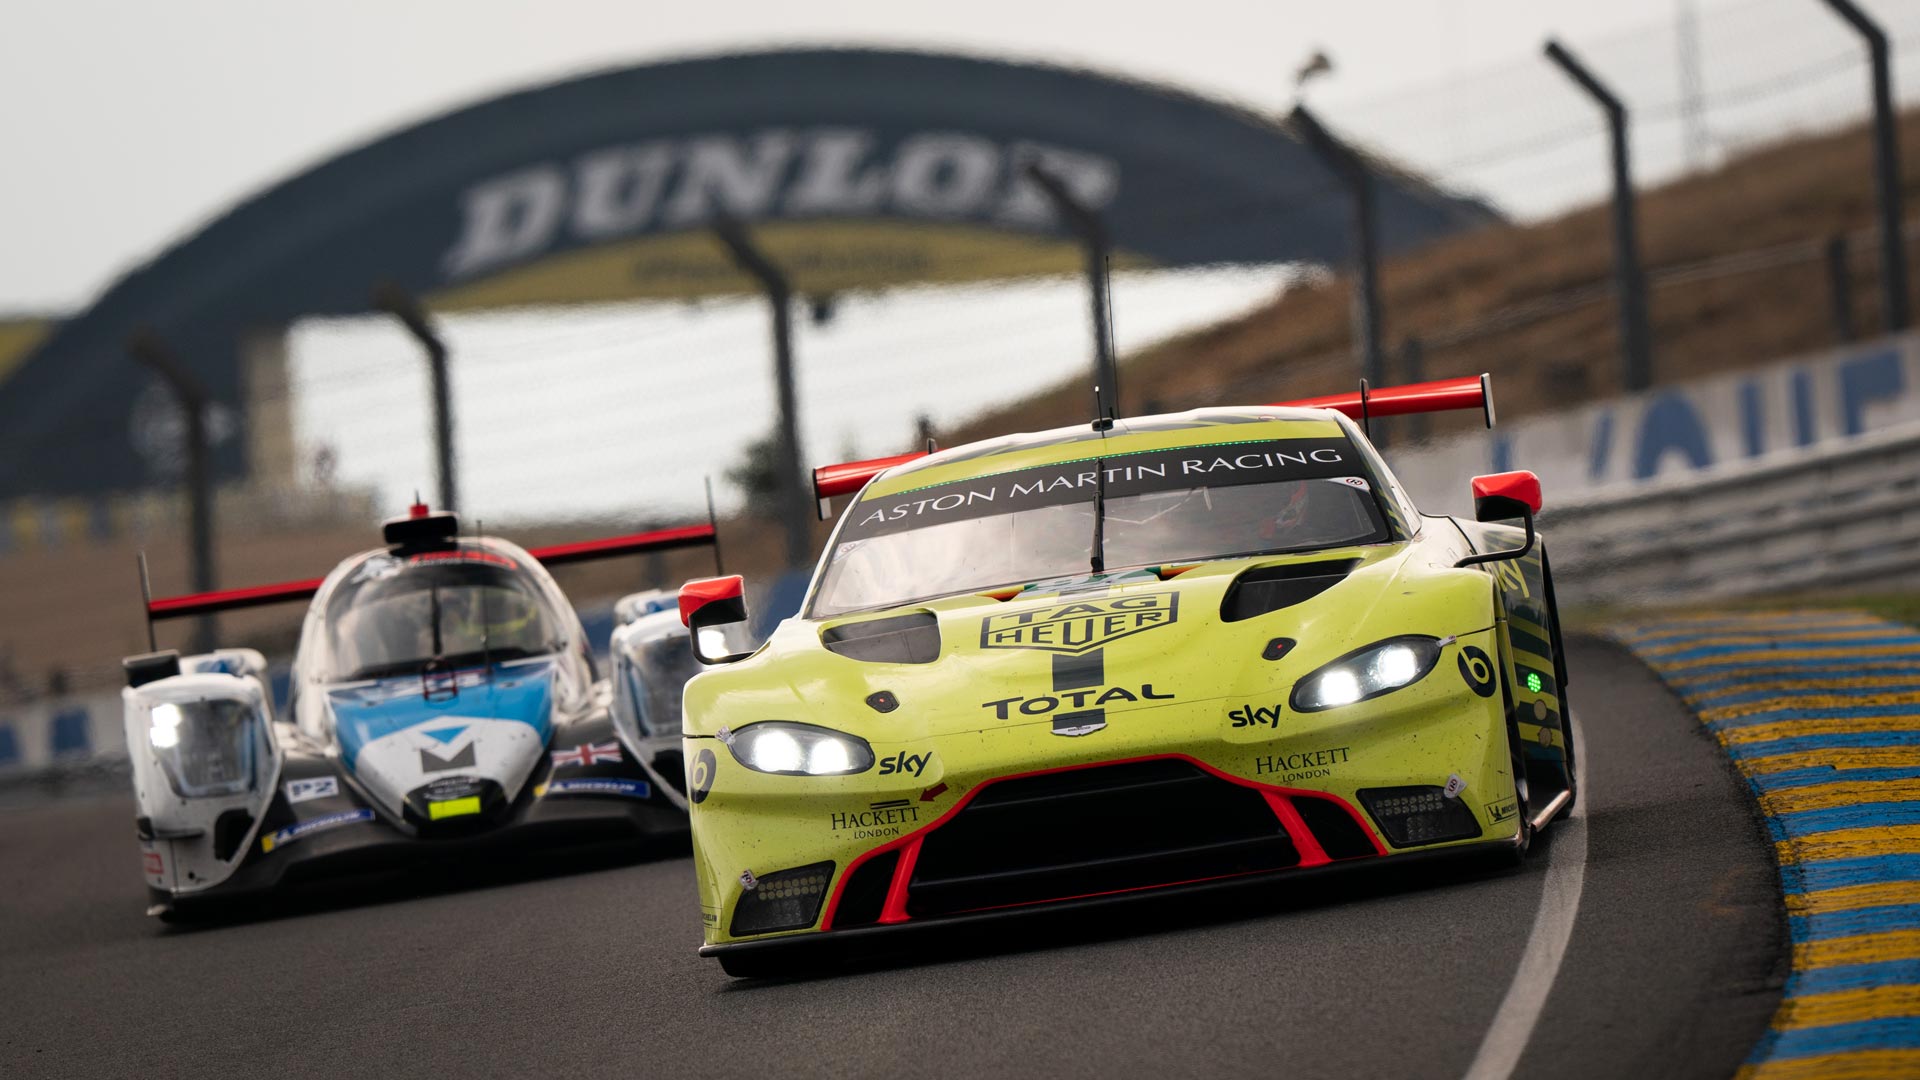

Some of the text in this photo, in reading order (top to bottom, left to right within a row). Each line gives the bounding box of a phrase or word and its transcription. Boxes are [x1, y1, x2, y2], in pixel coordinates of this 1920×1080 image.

[445, 132, 1118, 276] DUNLOP
[860, 448, 1342, 527] ASTON MARTIN RACING
[1001, 596, 1157, 625] TAG
[995, 612, 1163, 646] HEUER
[982, 684, 1175, 720] TOTAL
[1228, 704, 1282, 729] sky
[879, 751, 933, 778] sky
[1255, 747, 1350, 775] HACKETT
[1282, 768, 1331, 783] LONDON
[831, 806, 920, 831] HACKETT
[854, 826, 900, 840] LONDON
